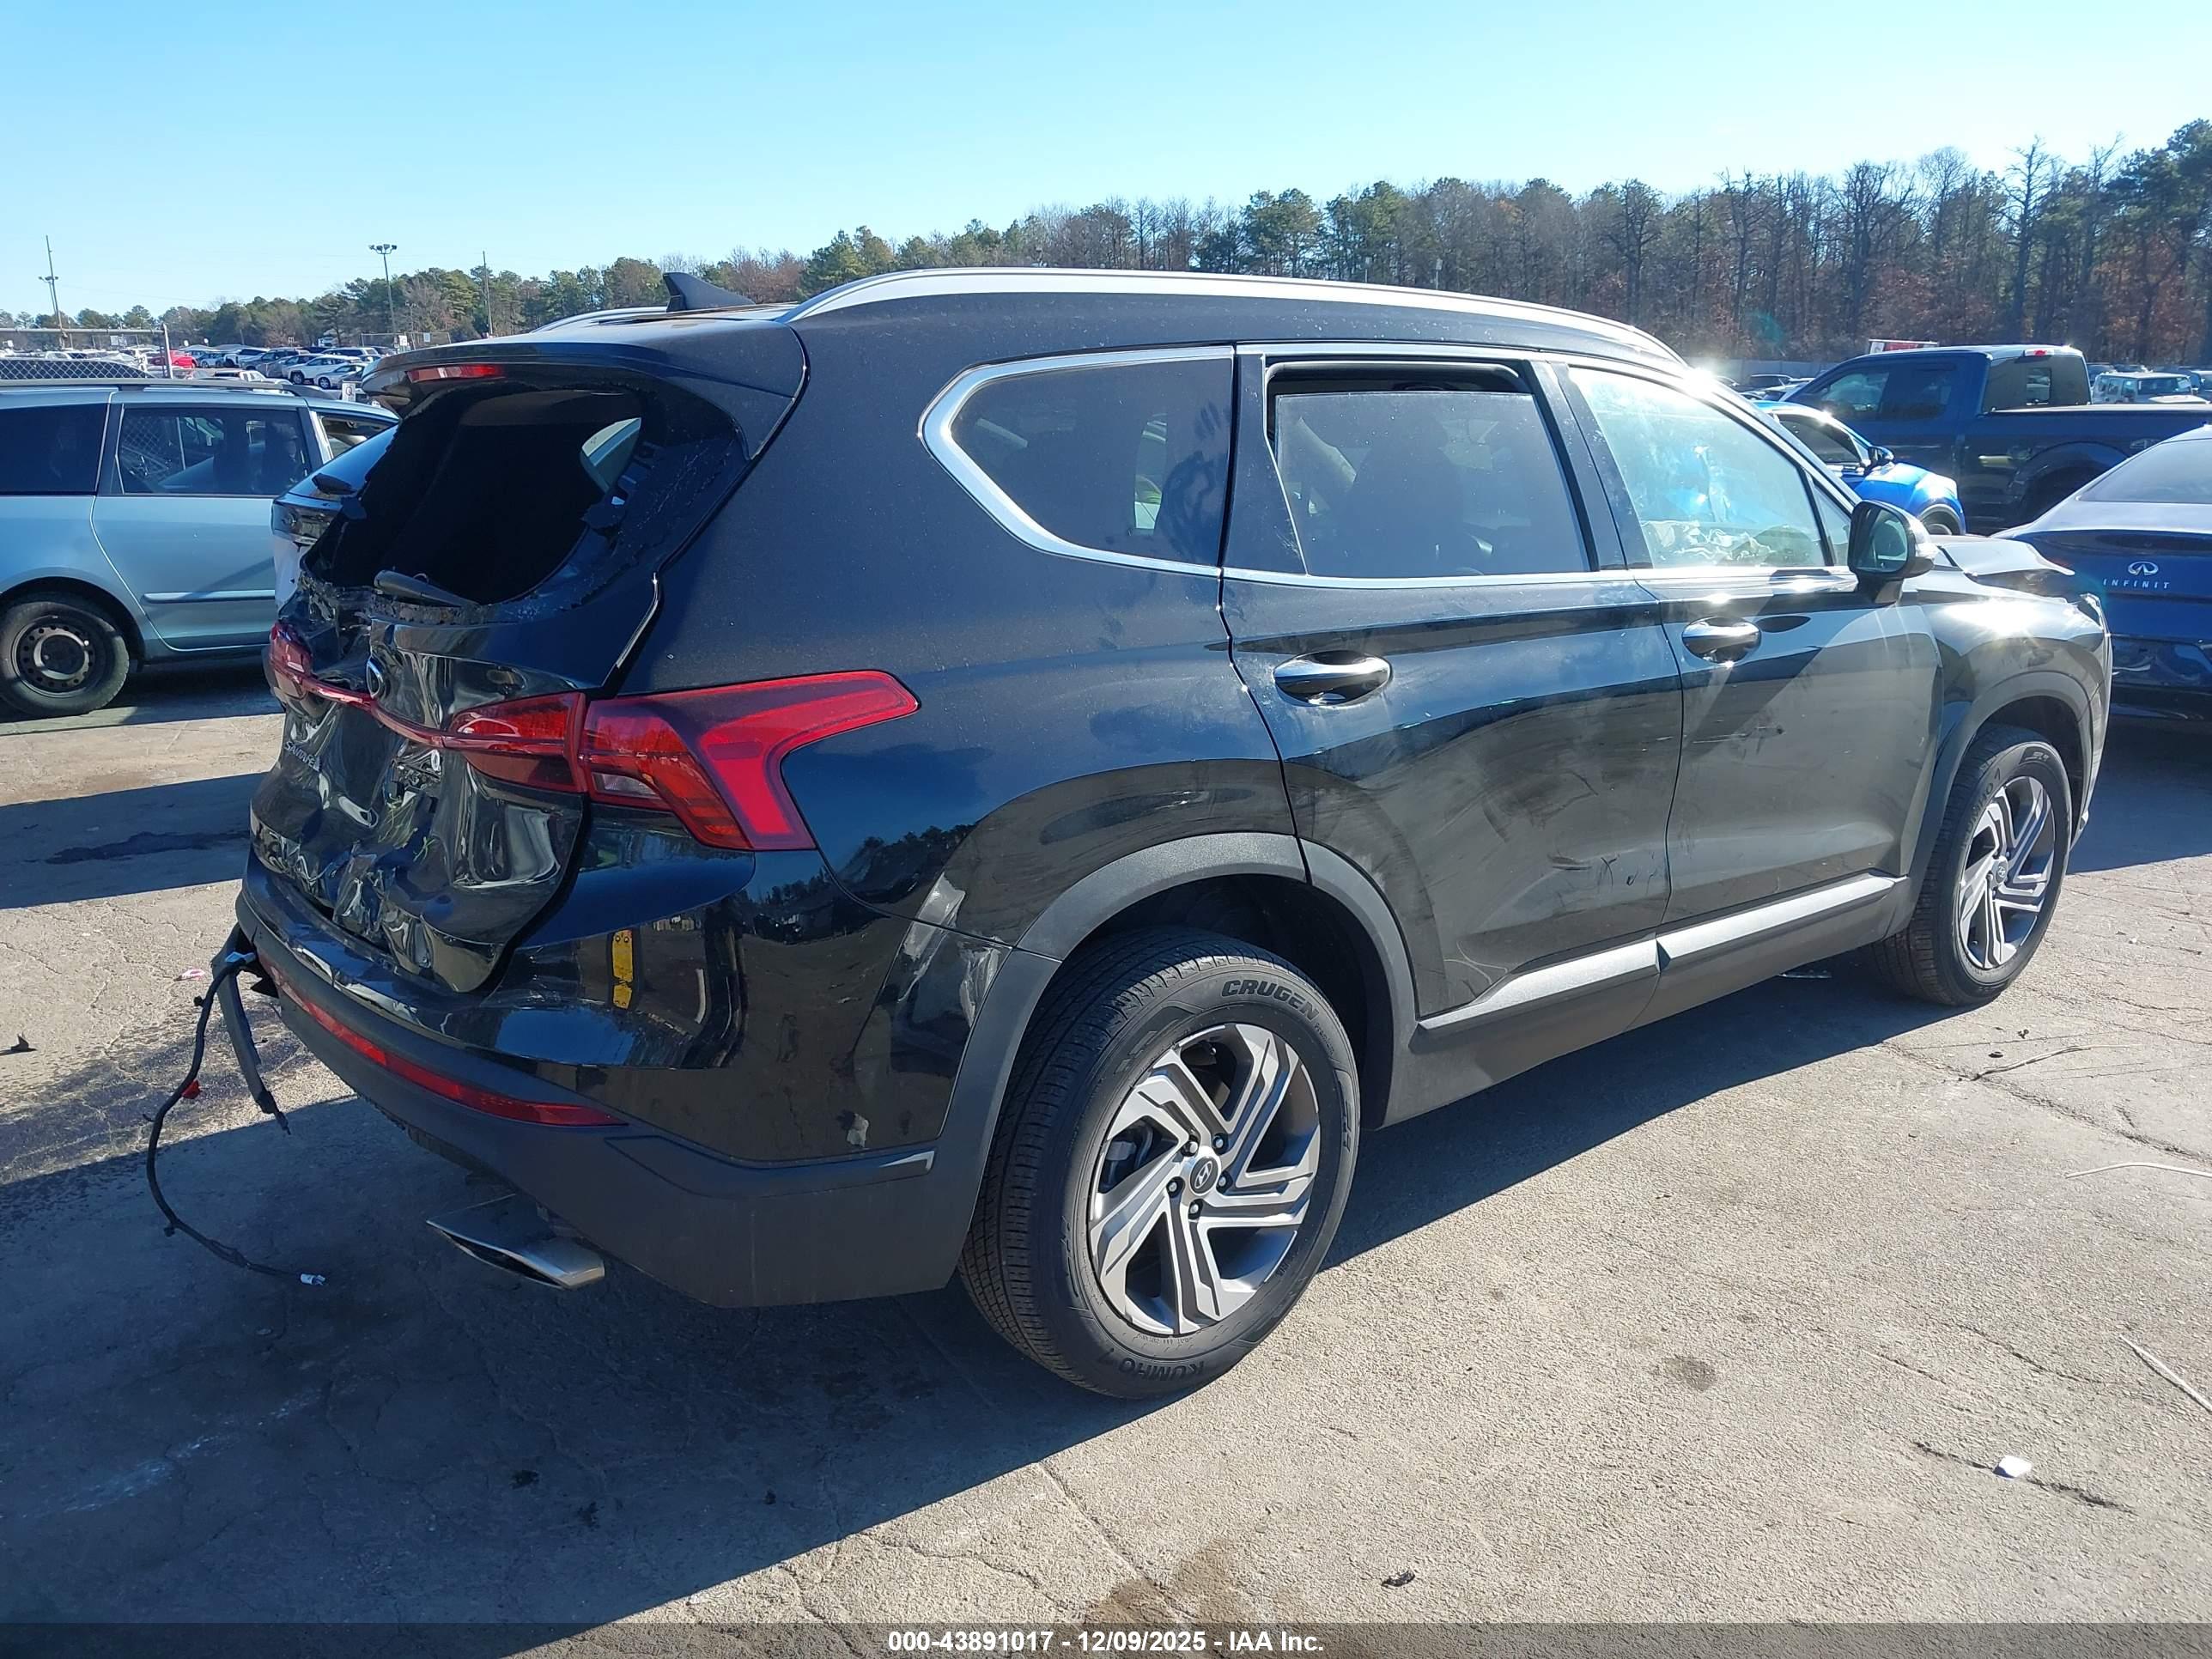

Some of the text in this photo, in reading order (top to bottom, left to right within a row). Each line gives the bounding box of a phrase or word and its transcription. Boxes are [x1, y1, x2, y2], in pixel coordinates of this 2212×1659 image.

[2103, 579, 2170, 589] INFINIT
[1221, 979, 1320, 1021] CRUGEN
[1118, 1357, 1205, 1381] KUMHO
